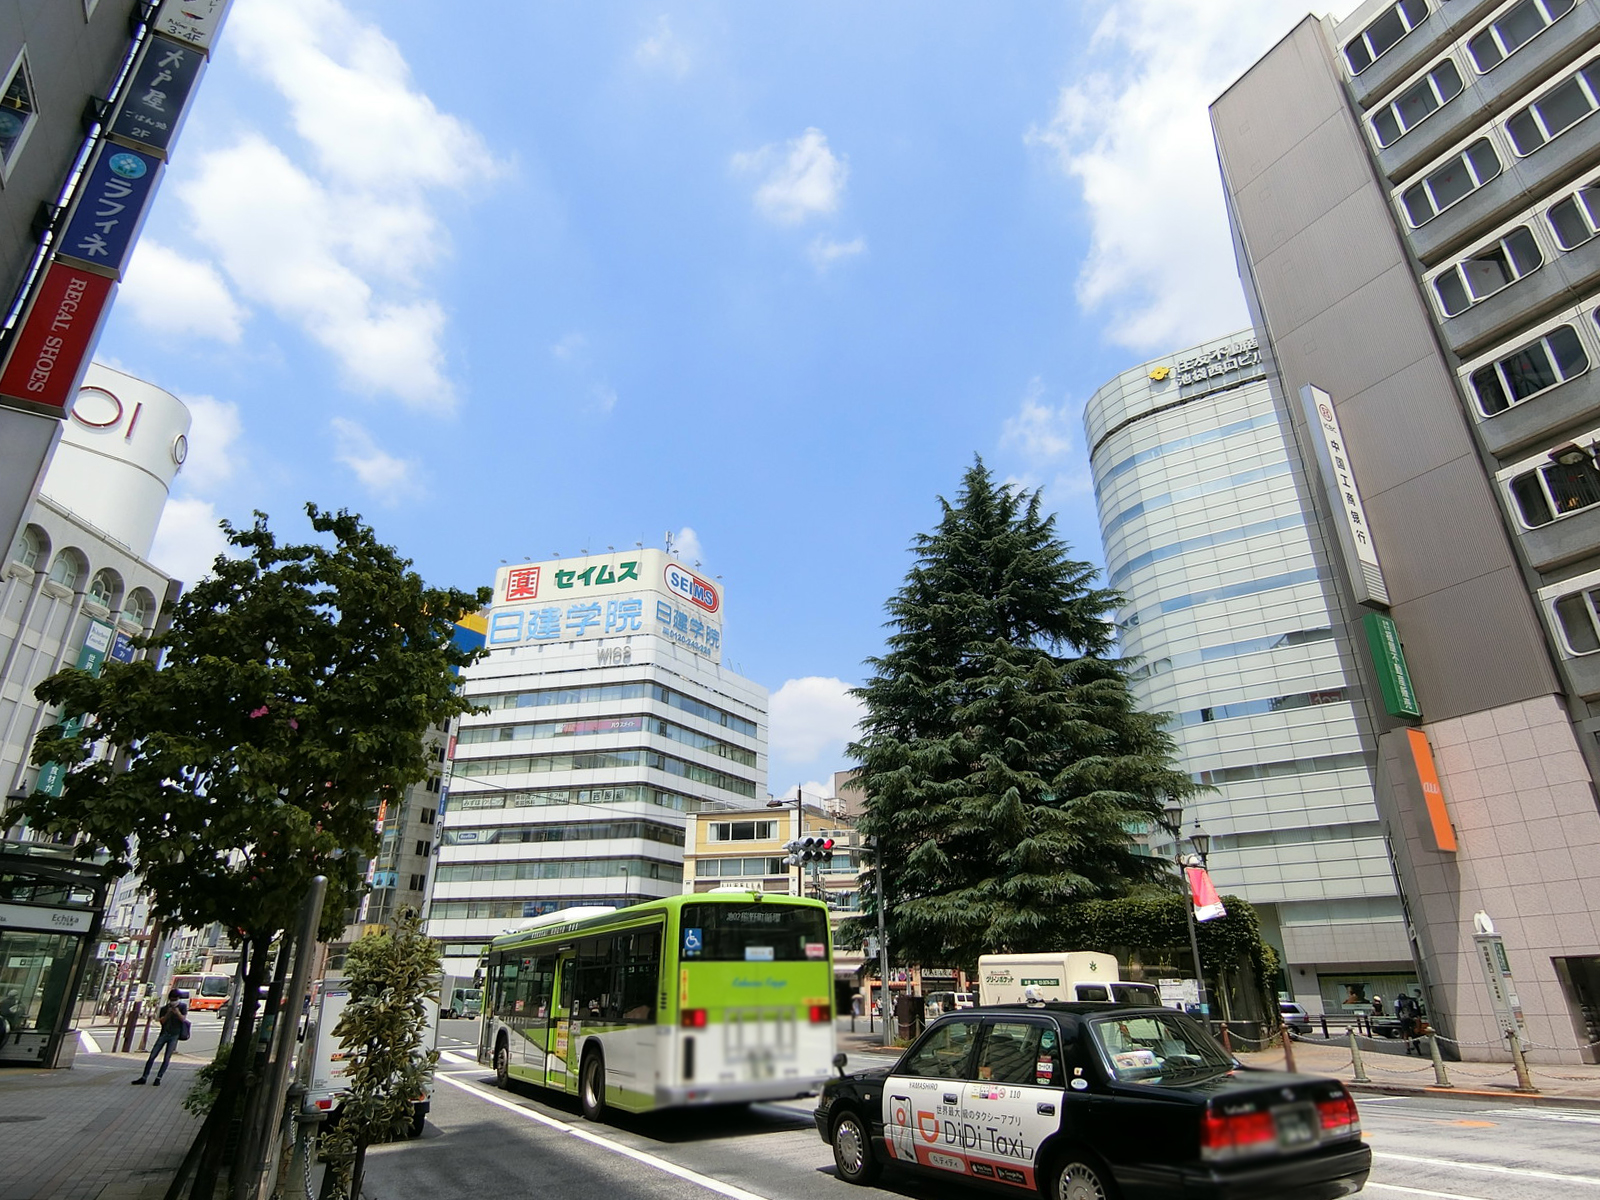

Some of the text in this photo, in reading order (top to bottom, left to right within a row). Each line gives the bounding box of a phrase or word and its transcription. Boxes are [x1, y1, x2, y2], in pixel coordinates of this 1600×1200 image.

[142, 50, 185, 112] 大戸屋
[131, 127, 151, 138] 2F
[77, 178, 133, 257] ラフィネ
[27, 277, 88, 393] REGAL SHOES
[1177, 350, 1262, 386] 池袋西口ビル
[508, 561, 638, 599] 薬 セイムス
[670, 571, 713, 606] SEIMS
[489, 599, 643, 645] 日建学院
[656, 600, 720, 649] 日建学院
[1423, 782, 1439, 794] au
[52, 914, 80, 923] Echika
[909, 1082, 938, 1090] YAMASHIRO
[1009, 1090, 1021, 1099] 110
[936, 1105, 1021, 1126] 世界最大級のタクシーアプリ
[944, 1120, 1026, 1158] DiDi Taxi
